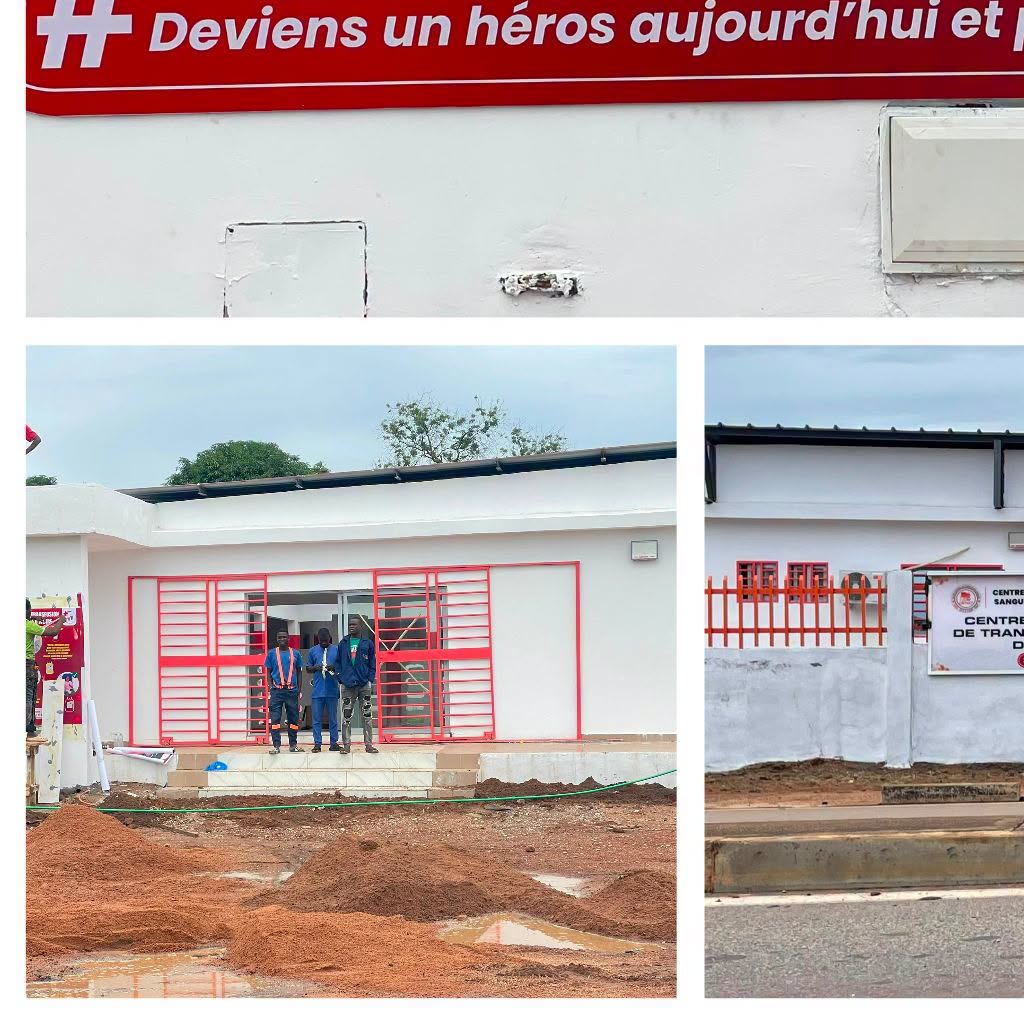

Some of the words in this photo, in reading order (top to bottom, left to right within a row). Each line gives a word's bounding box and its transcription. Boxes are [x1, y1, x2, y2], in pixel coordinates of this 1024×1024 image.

[149, 6, 367, 51] Deviens
[384, 16, 451, 46] un
[466, 1, 615, 45] héros
[952, 1, 1003, 38] et
[953, 629, 975, 637] DE
